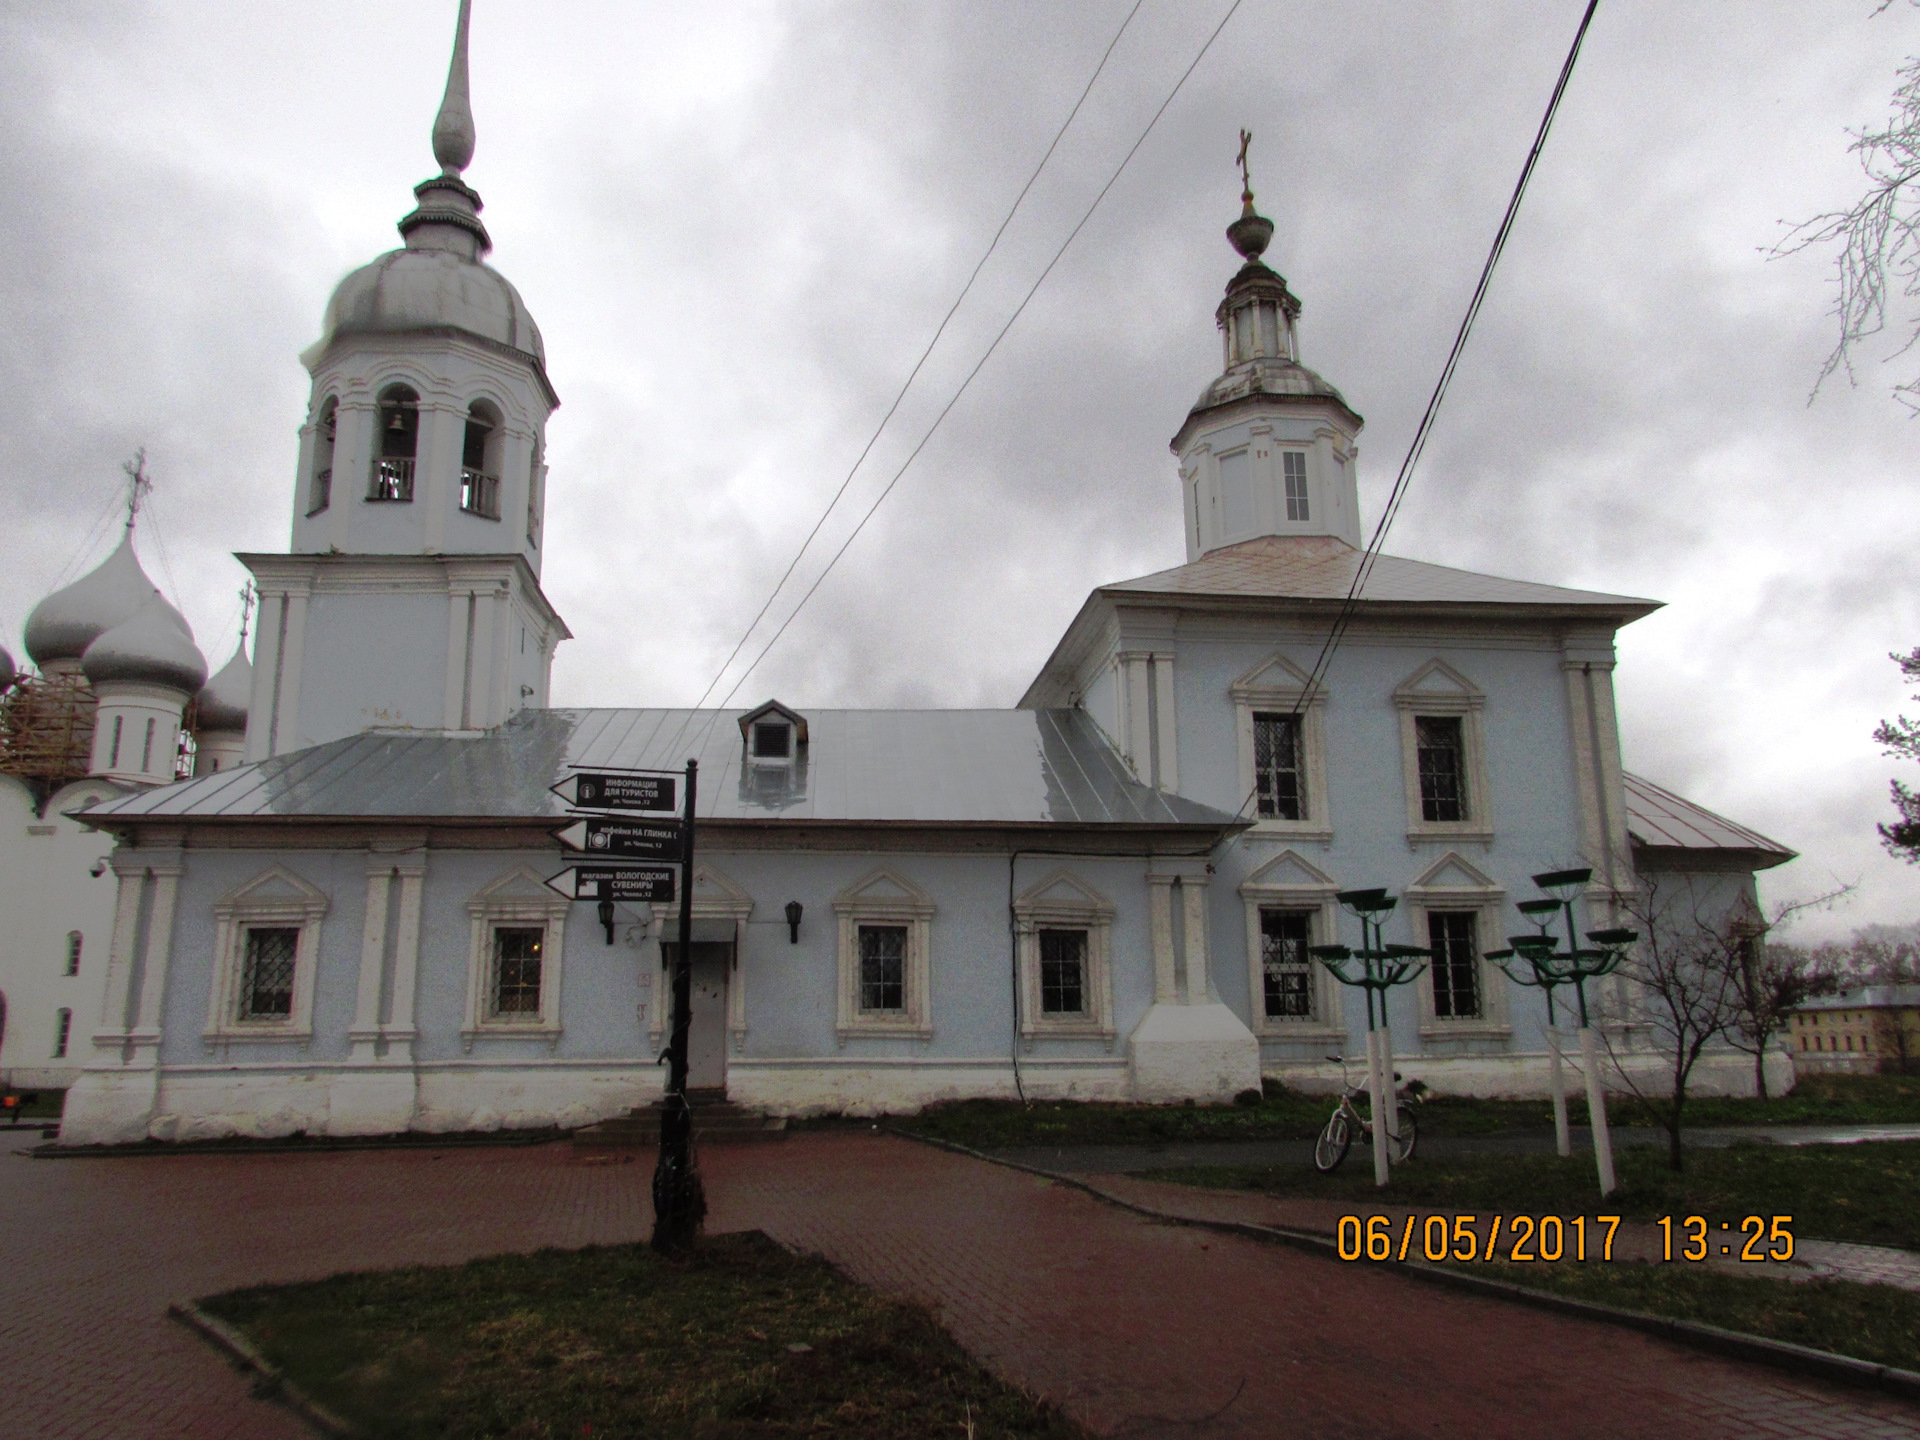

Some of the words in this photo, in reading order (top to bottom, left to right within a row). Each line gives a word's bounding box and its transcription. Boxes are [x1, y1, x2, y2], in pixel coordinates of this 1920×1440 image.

[605, 779, 658, 789] ИНФОРМАЦИЯ
[604, 788, 620, 797] ДЛЯ
[621, 788, 659, 798] ТУРИСТОВ
[632, 828, 643, 836] НА
[615, 871, 670, 881] ВОЛОГОДСКИЕ
[611, 881, 654, 889] СУВЕНИРЫ
